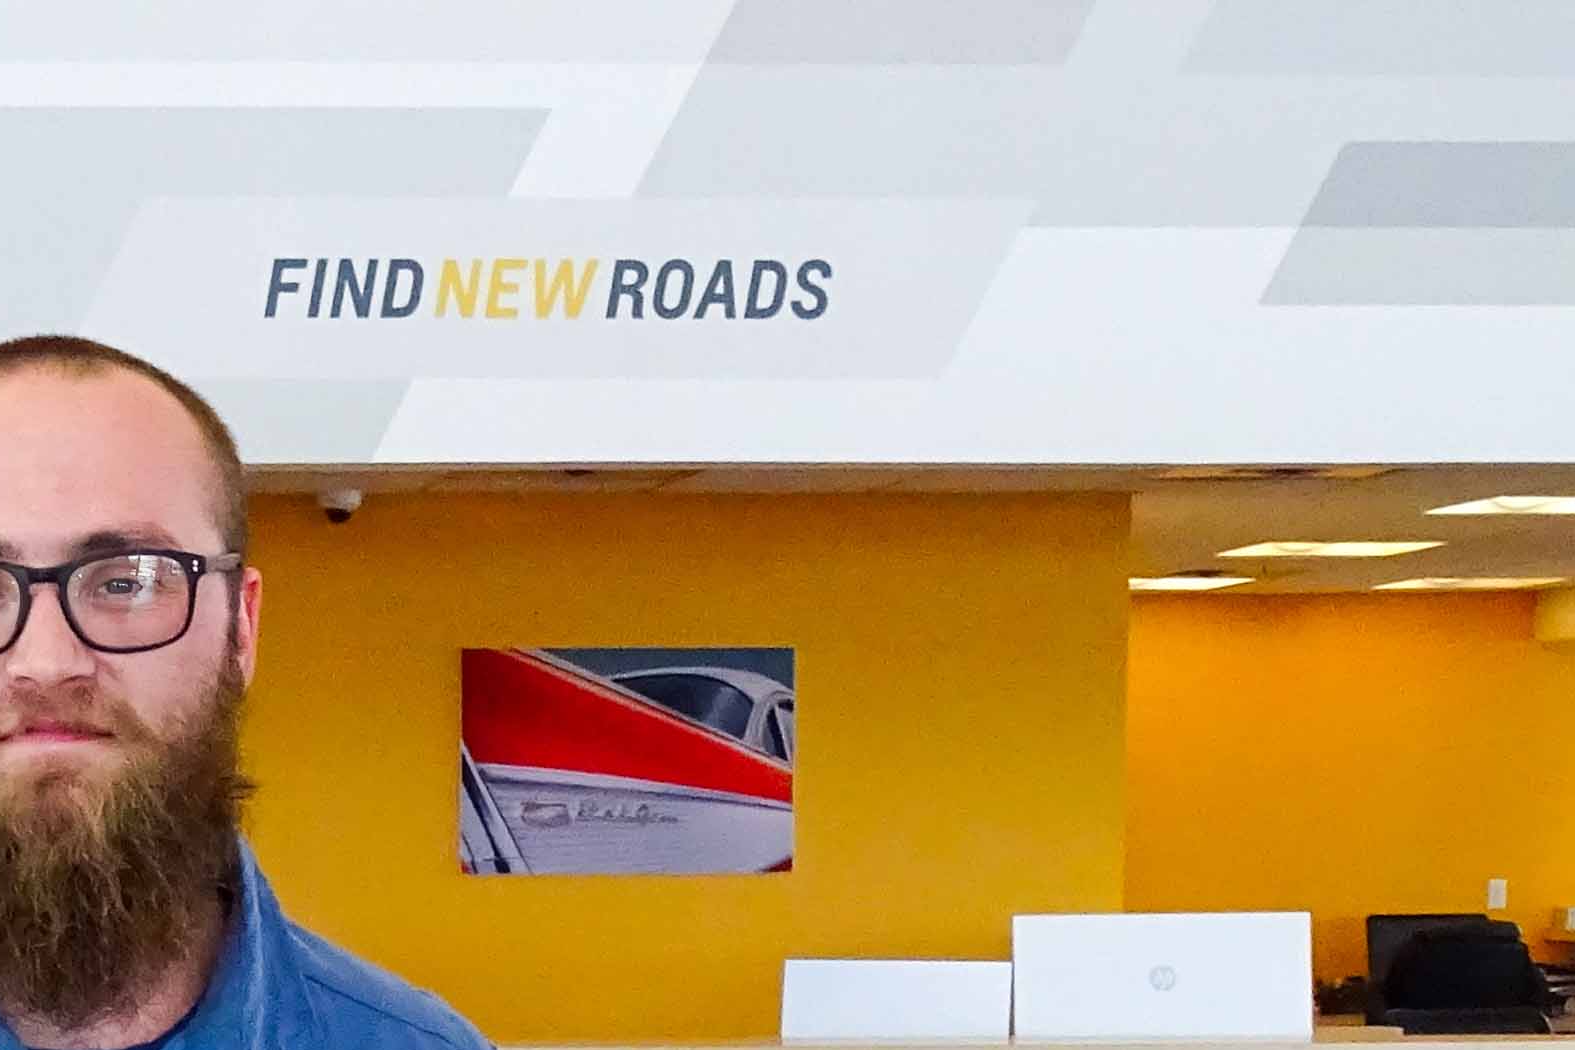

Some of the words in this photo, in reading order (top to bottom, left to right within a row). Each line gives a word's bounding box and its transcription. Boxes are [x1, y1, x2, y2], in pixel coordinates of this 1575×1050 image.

[264, 257, 424, 320] FIND
[433, 257, 601, 321] NEW
[606, 257, 834, 321] ROADS
